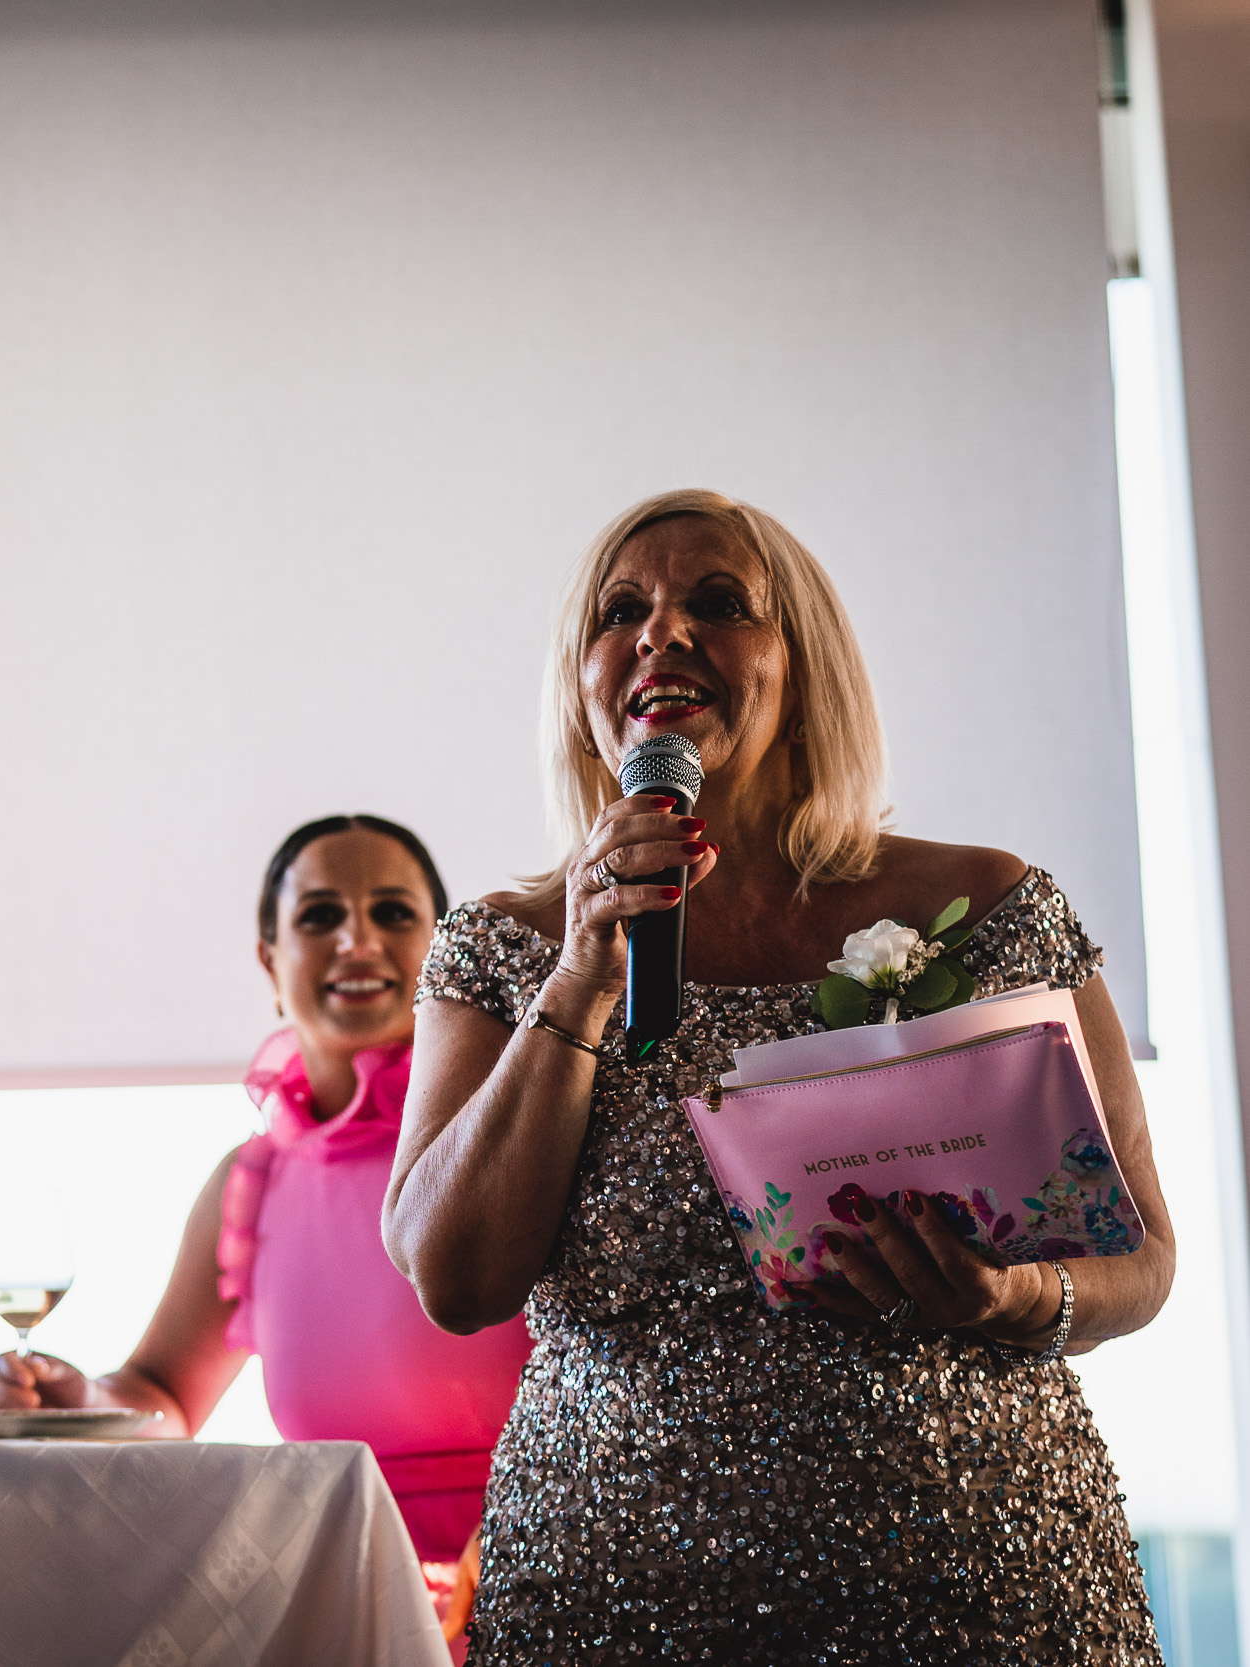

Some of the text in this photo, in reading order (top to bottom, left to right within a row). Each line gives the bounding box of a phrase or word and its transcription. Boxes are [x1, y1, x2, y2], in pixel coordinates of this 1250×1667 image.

[804, 1134, 986, 1175] MOTHER OF THE BRIDE
